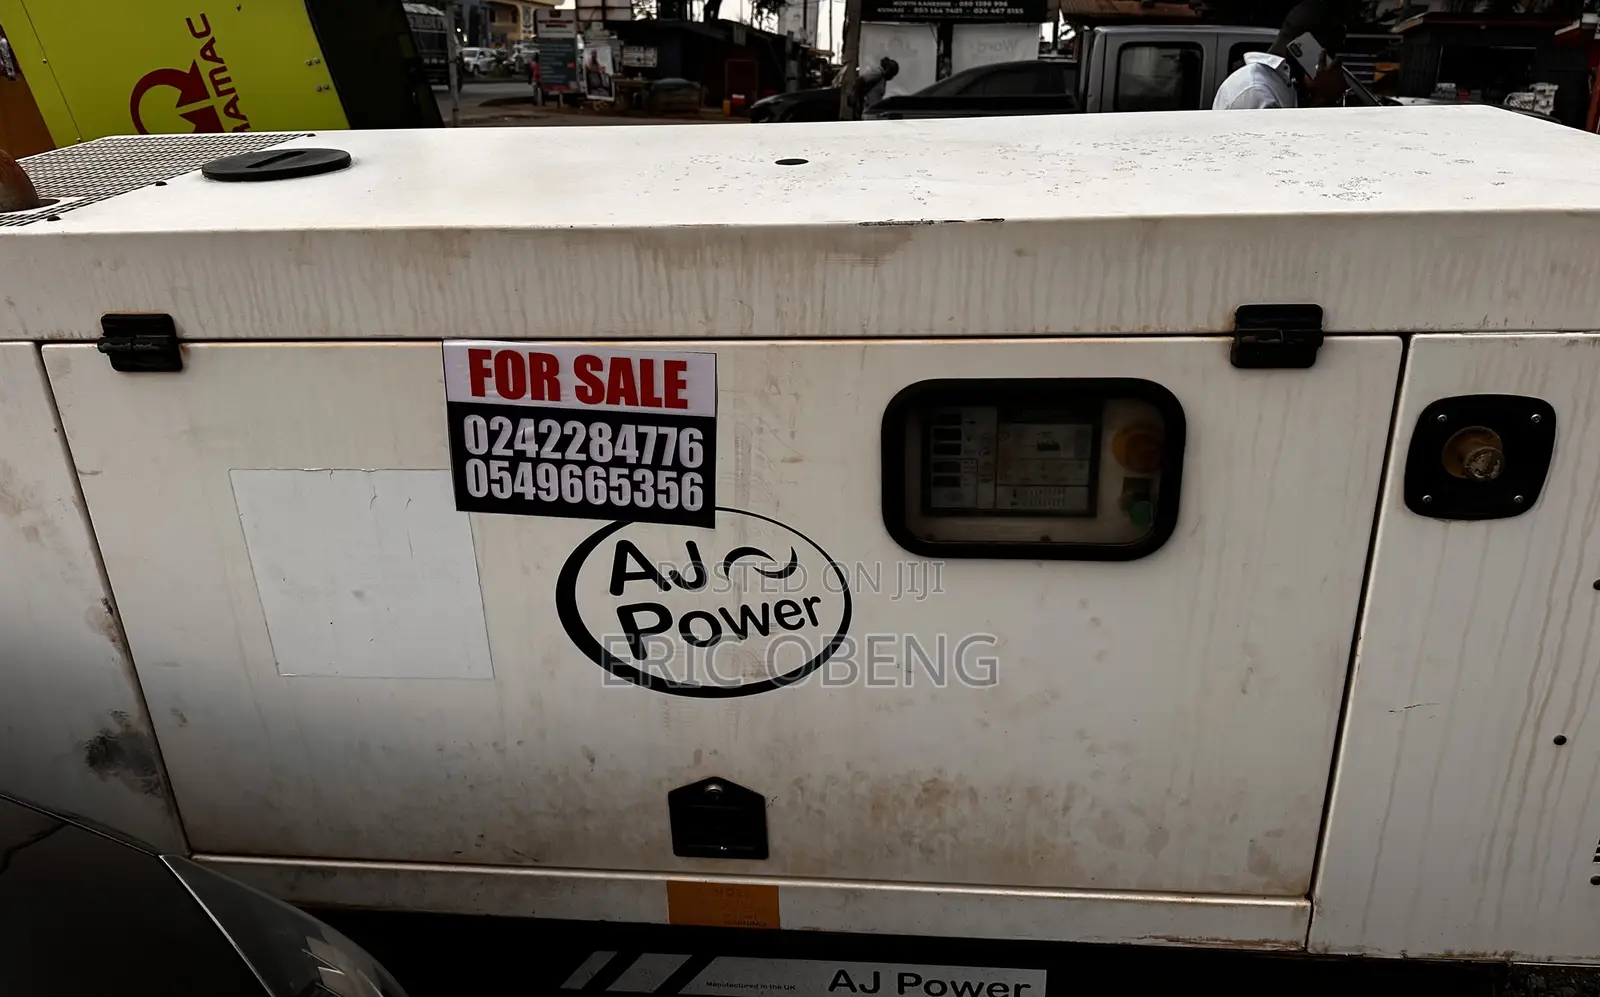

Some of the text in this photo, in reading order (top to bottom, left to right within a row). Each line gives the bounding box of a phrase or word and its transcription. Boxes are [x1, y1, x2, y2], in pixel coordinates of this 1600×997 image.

[467, 348, 688, 409] FOR SALE
[463, 414, 704, 468] 0242284776
[465, 458, 704, 512] 0549665356
[609, 539, 708, 596] AJ
[616, 595, 822, 661] Power
[705, 981, 759, 989] Manufactured
[827, 969, 1032, 997] AJ Power
